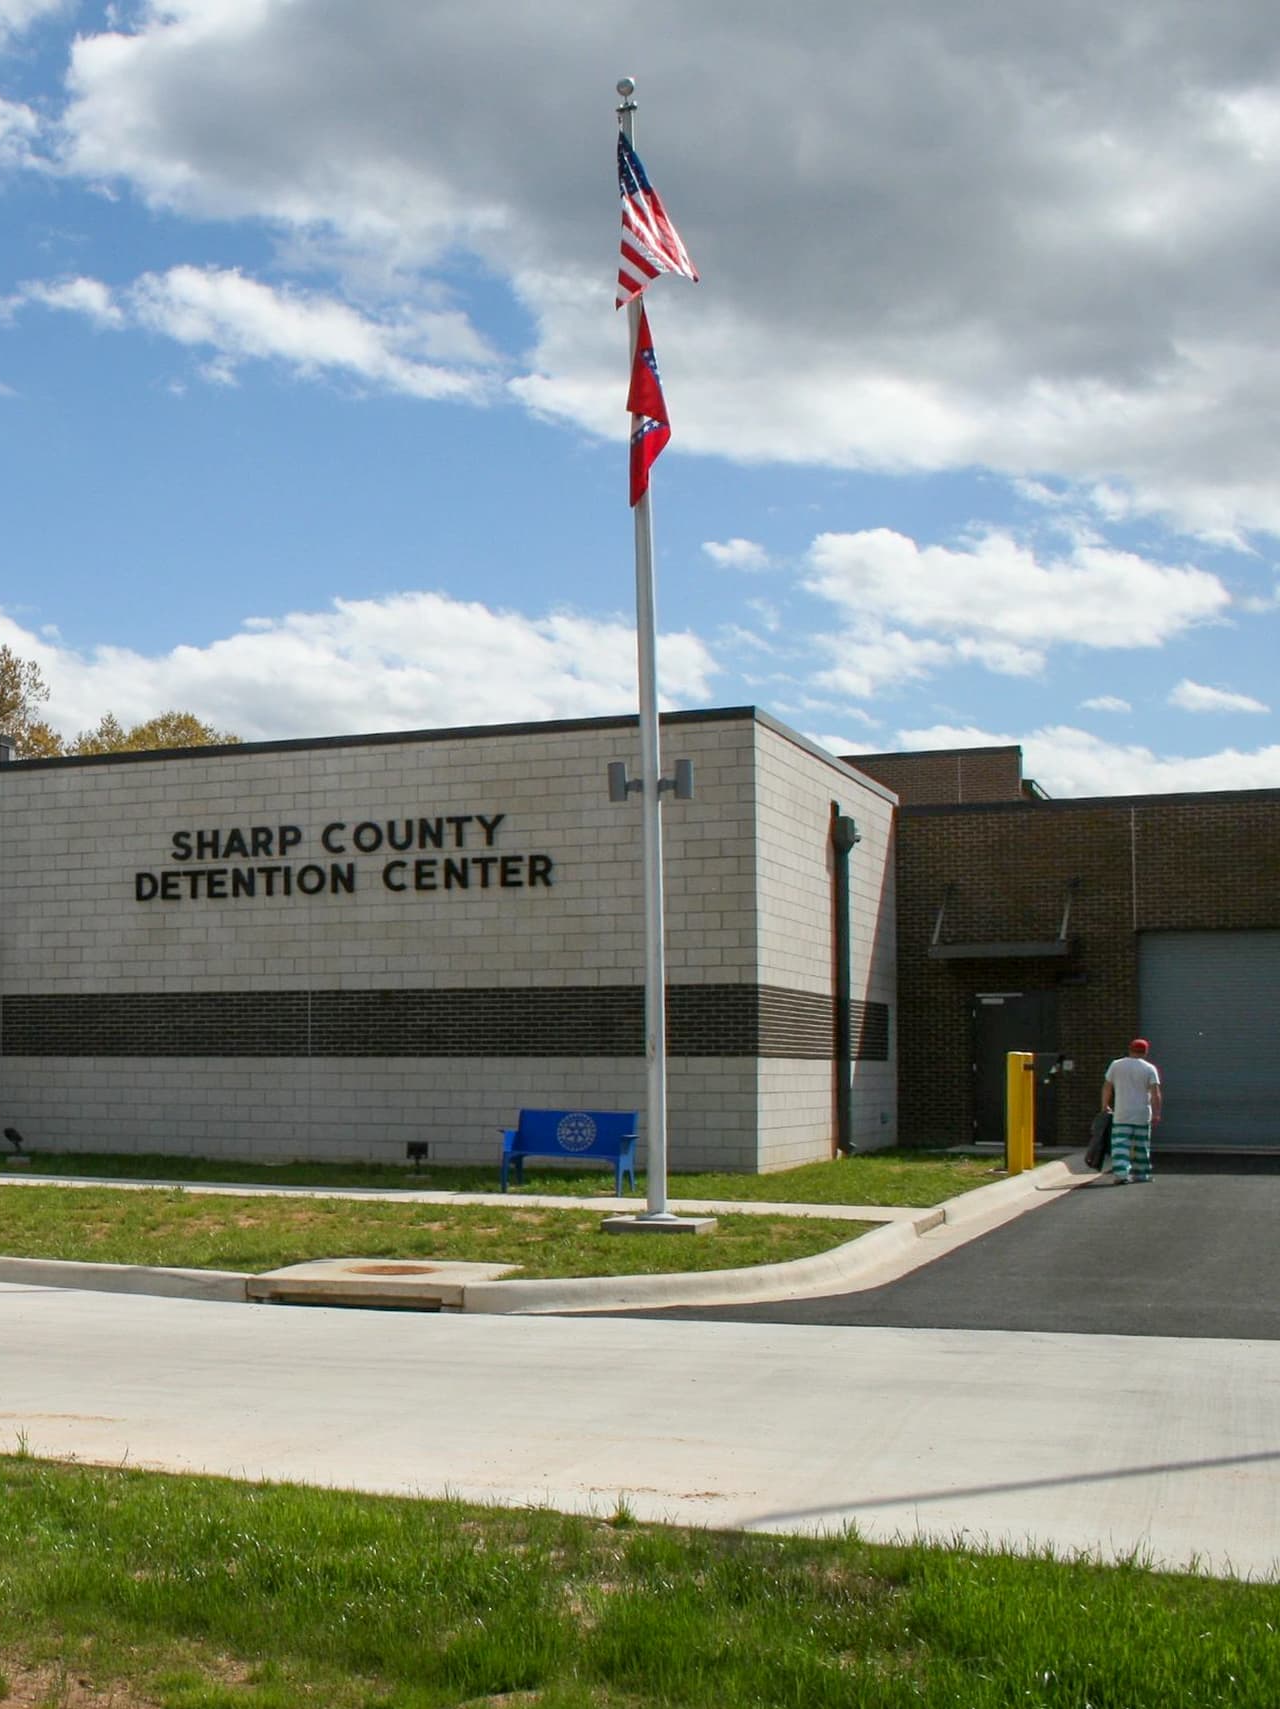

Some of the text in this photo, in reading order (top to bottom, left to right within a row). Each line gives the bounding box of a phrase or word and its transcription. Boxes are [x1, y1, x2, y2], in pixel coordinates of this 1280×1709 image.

[172, 813, 507, 862] SHARP COUNTY
[135, 854, 555, 902] DETENTION CENTER
